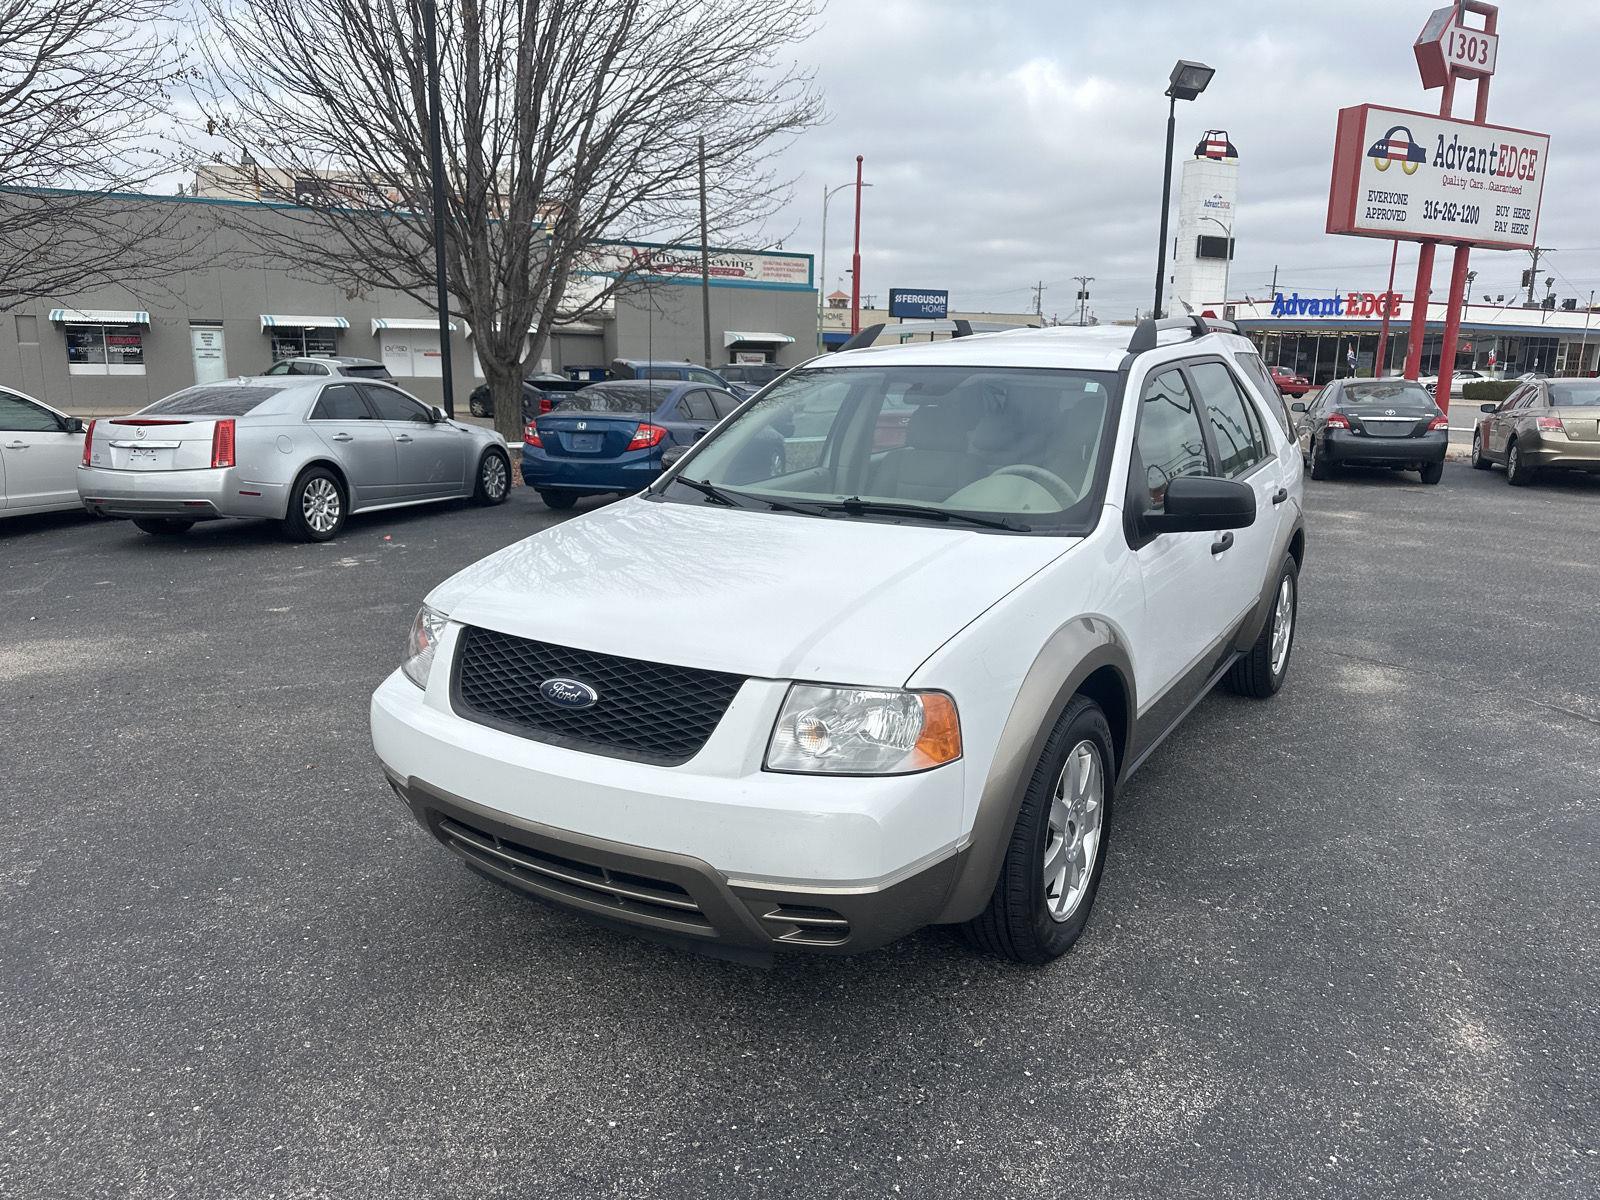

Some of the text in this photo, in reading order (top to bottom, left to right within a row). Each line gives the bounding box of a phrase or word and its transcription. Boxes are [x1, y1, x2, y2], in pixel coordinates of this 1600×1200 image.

[1448, 31, 1488, 65] 1303
[1432, 133, 1539, 182] AdvantEDGE
[1442, 174, 1468, 190] Quality
[1367, 189, 1409, 206] EVERYONE
[1365, 206, 1407, 222] APPROVED
[1423, 199, 1480, 225] 316-262-1200
[1495, 204, 1532, 220] BUY HERE
[1494, 220, 1529, 235] PAY HERE
[902, 294, 946, 305] FERGUSON
[921, 304, 946, 314] HOME
[109, 346, 141, 354] Simplicity
[548, 681, 582, 703] Ford
